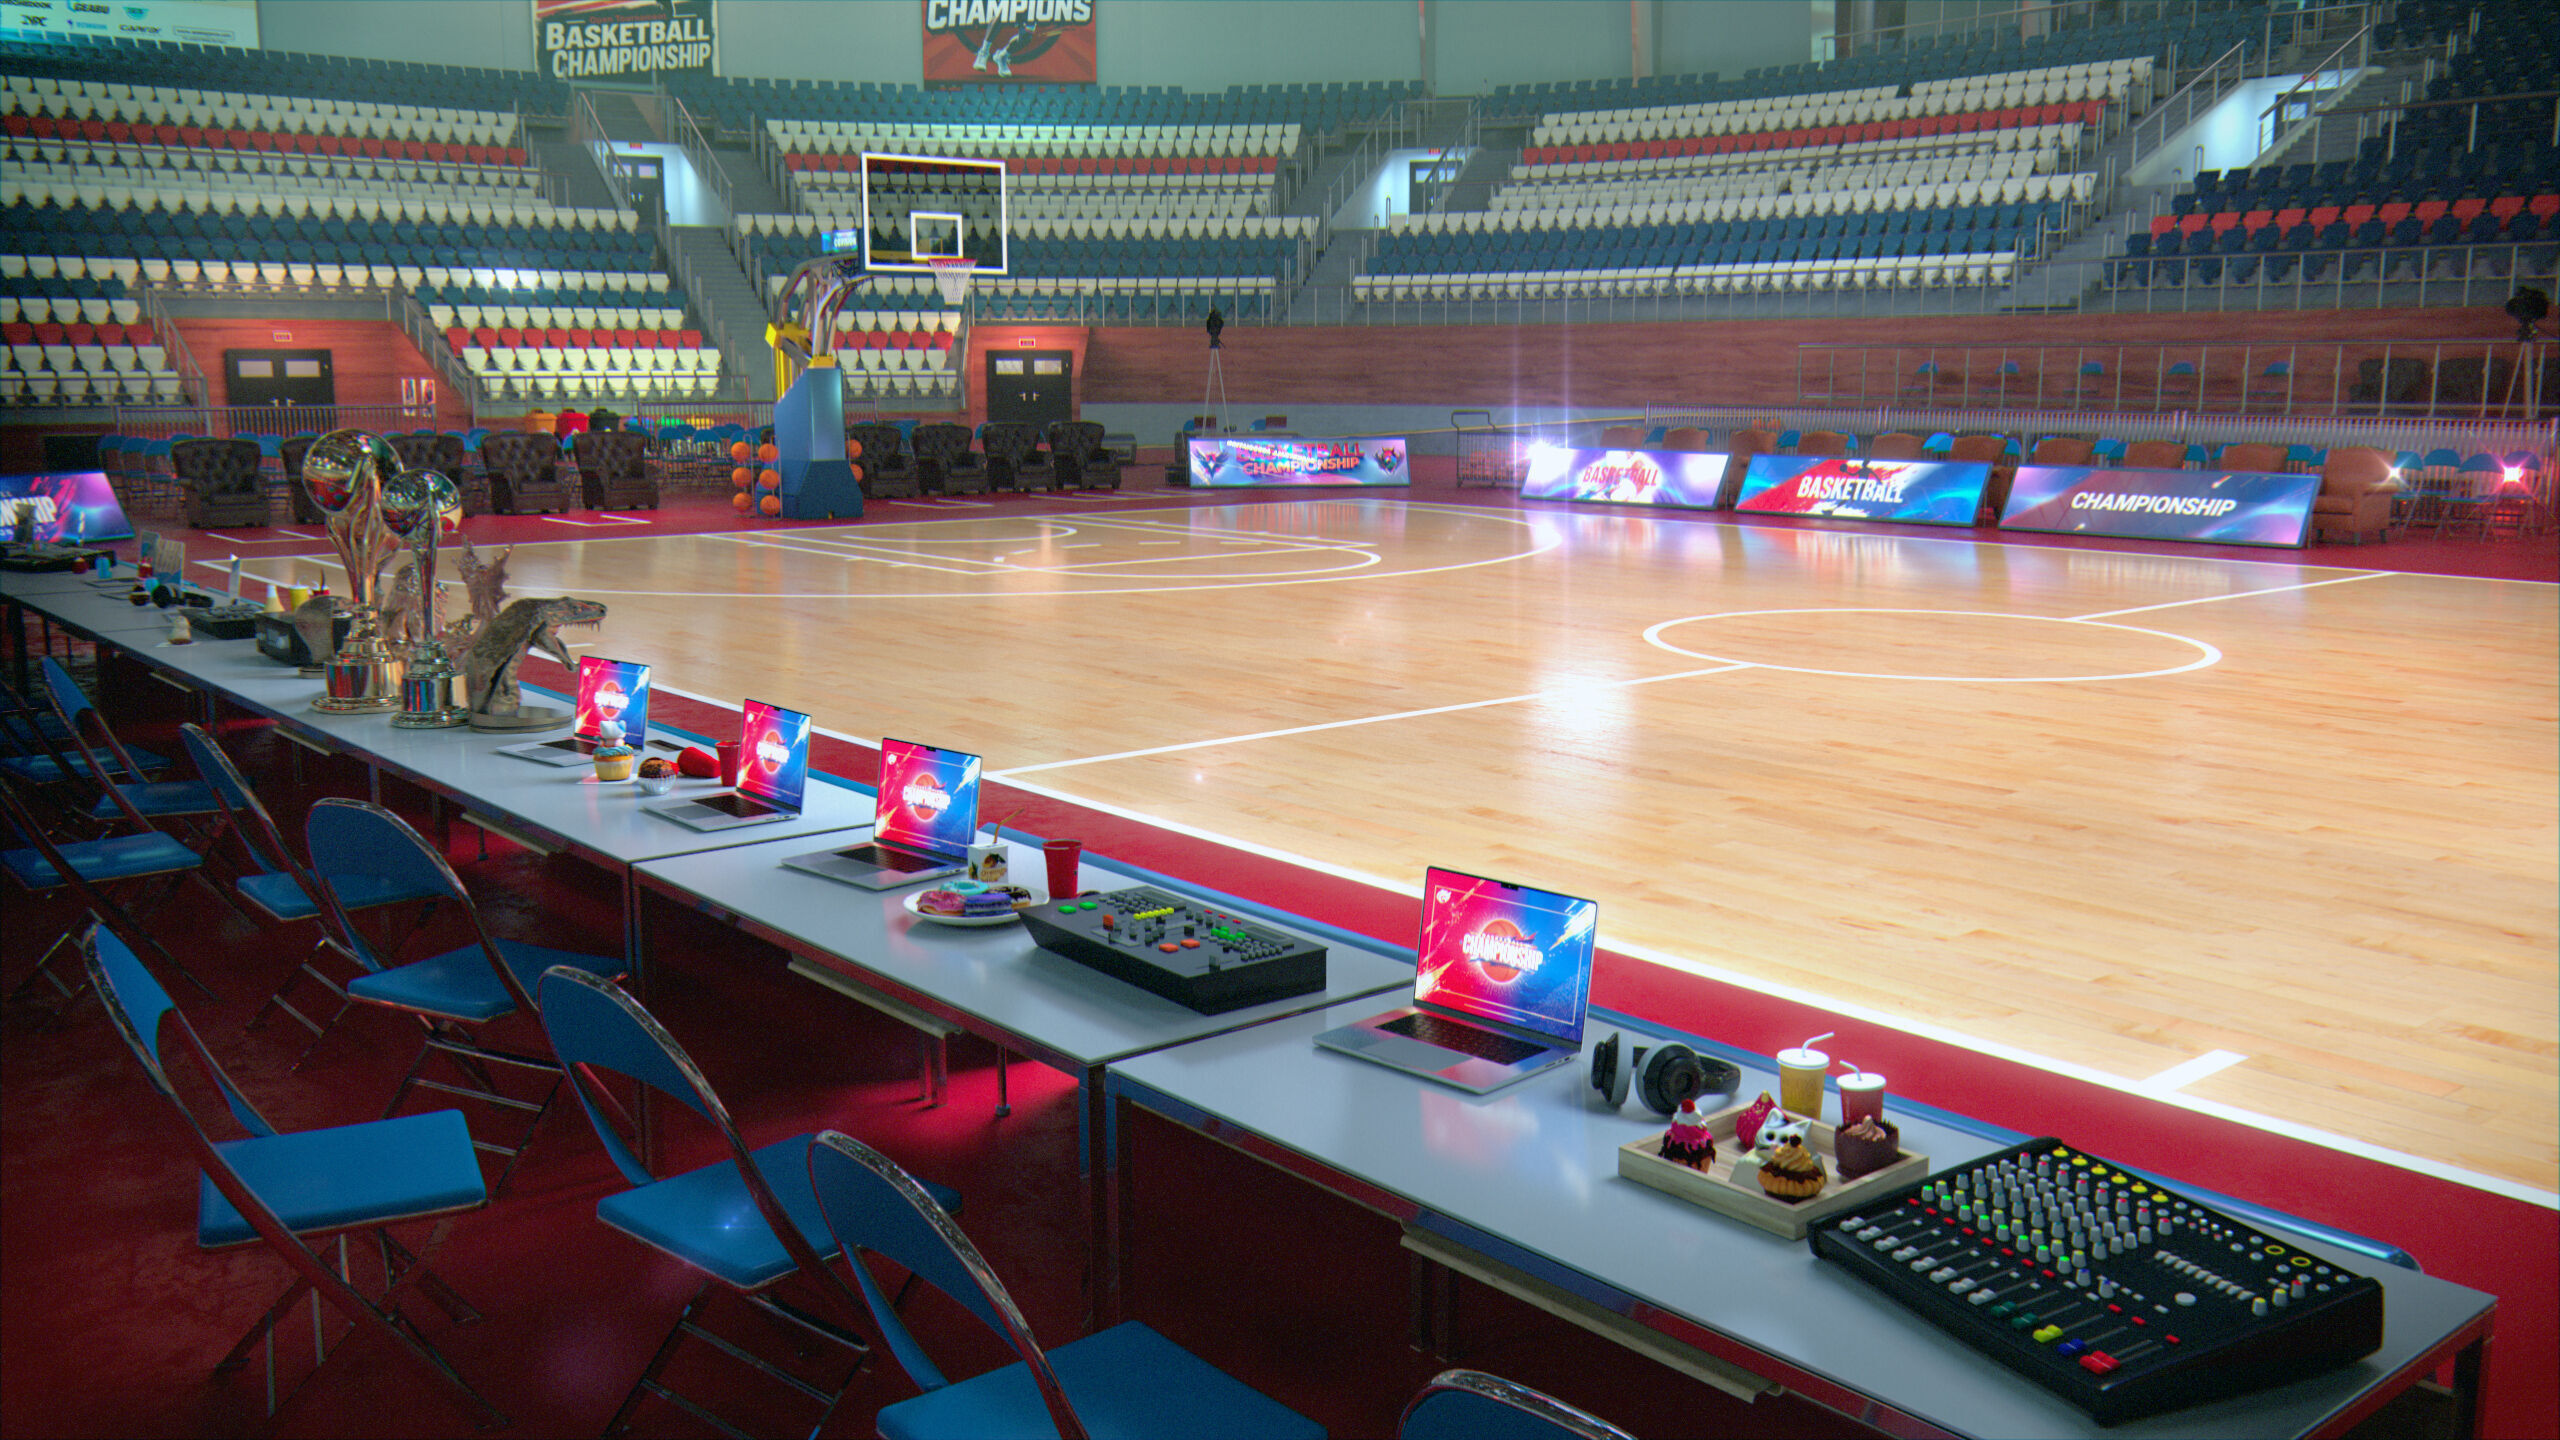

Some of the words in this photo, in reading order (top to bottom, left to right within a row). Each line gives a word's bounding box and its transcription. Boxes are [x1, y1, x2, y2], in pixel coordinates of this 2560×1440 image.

[928, 0, 1092, 30] CHAMPIONS
[546, 18, 710, 51] BASKETBALL
[552, 42, 711, 78] CHAMPIONSHIP
[1242, 456, 1360, 475] CHAMPIONSHIP
[1582, 466, 1659, 487] BASKETBALL
[1796, 475, 1903, 504] BASKETBALL
[2071, 491, 2237, 517] CHAMPIONSHIP
[1462, 932, 1544, 971] CHAMPIONSHIP
